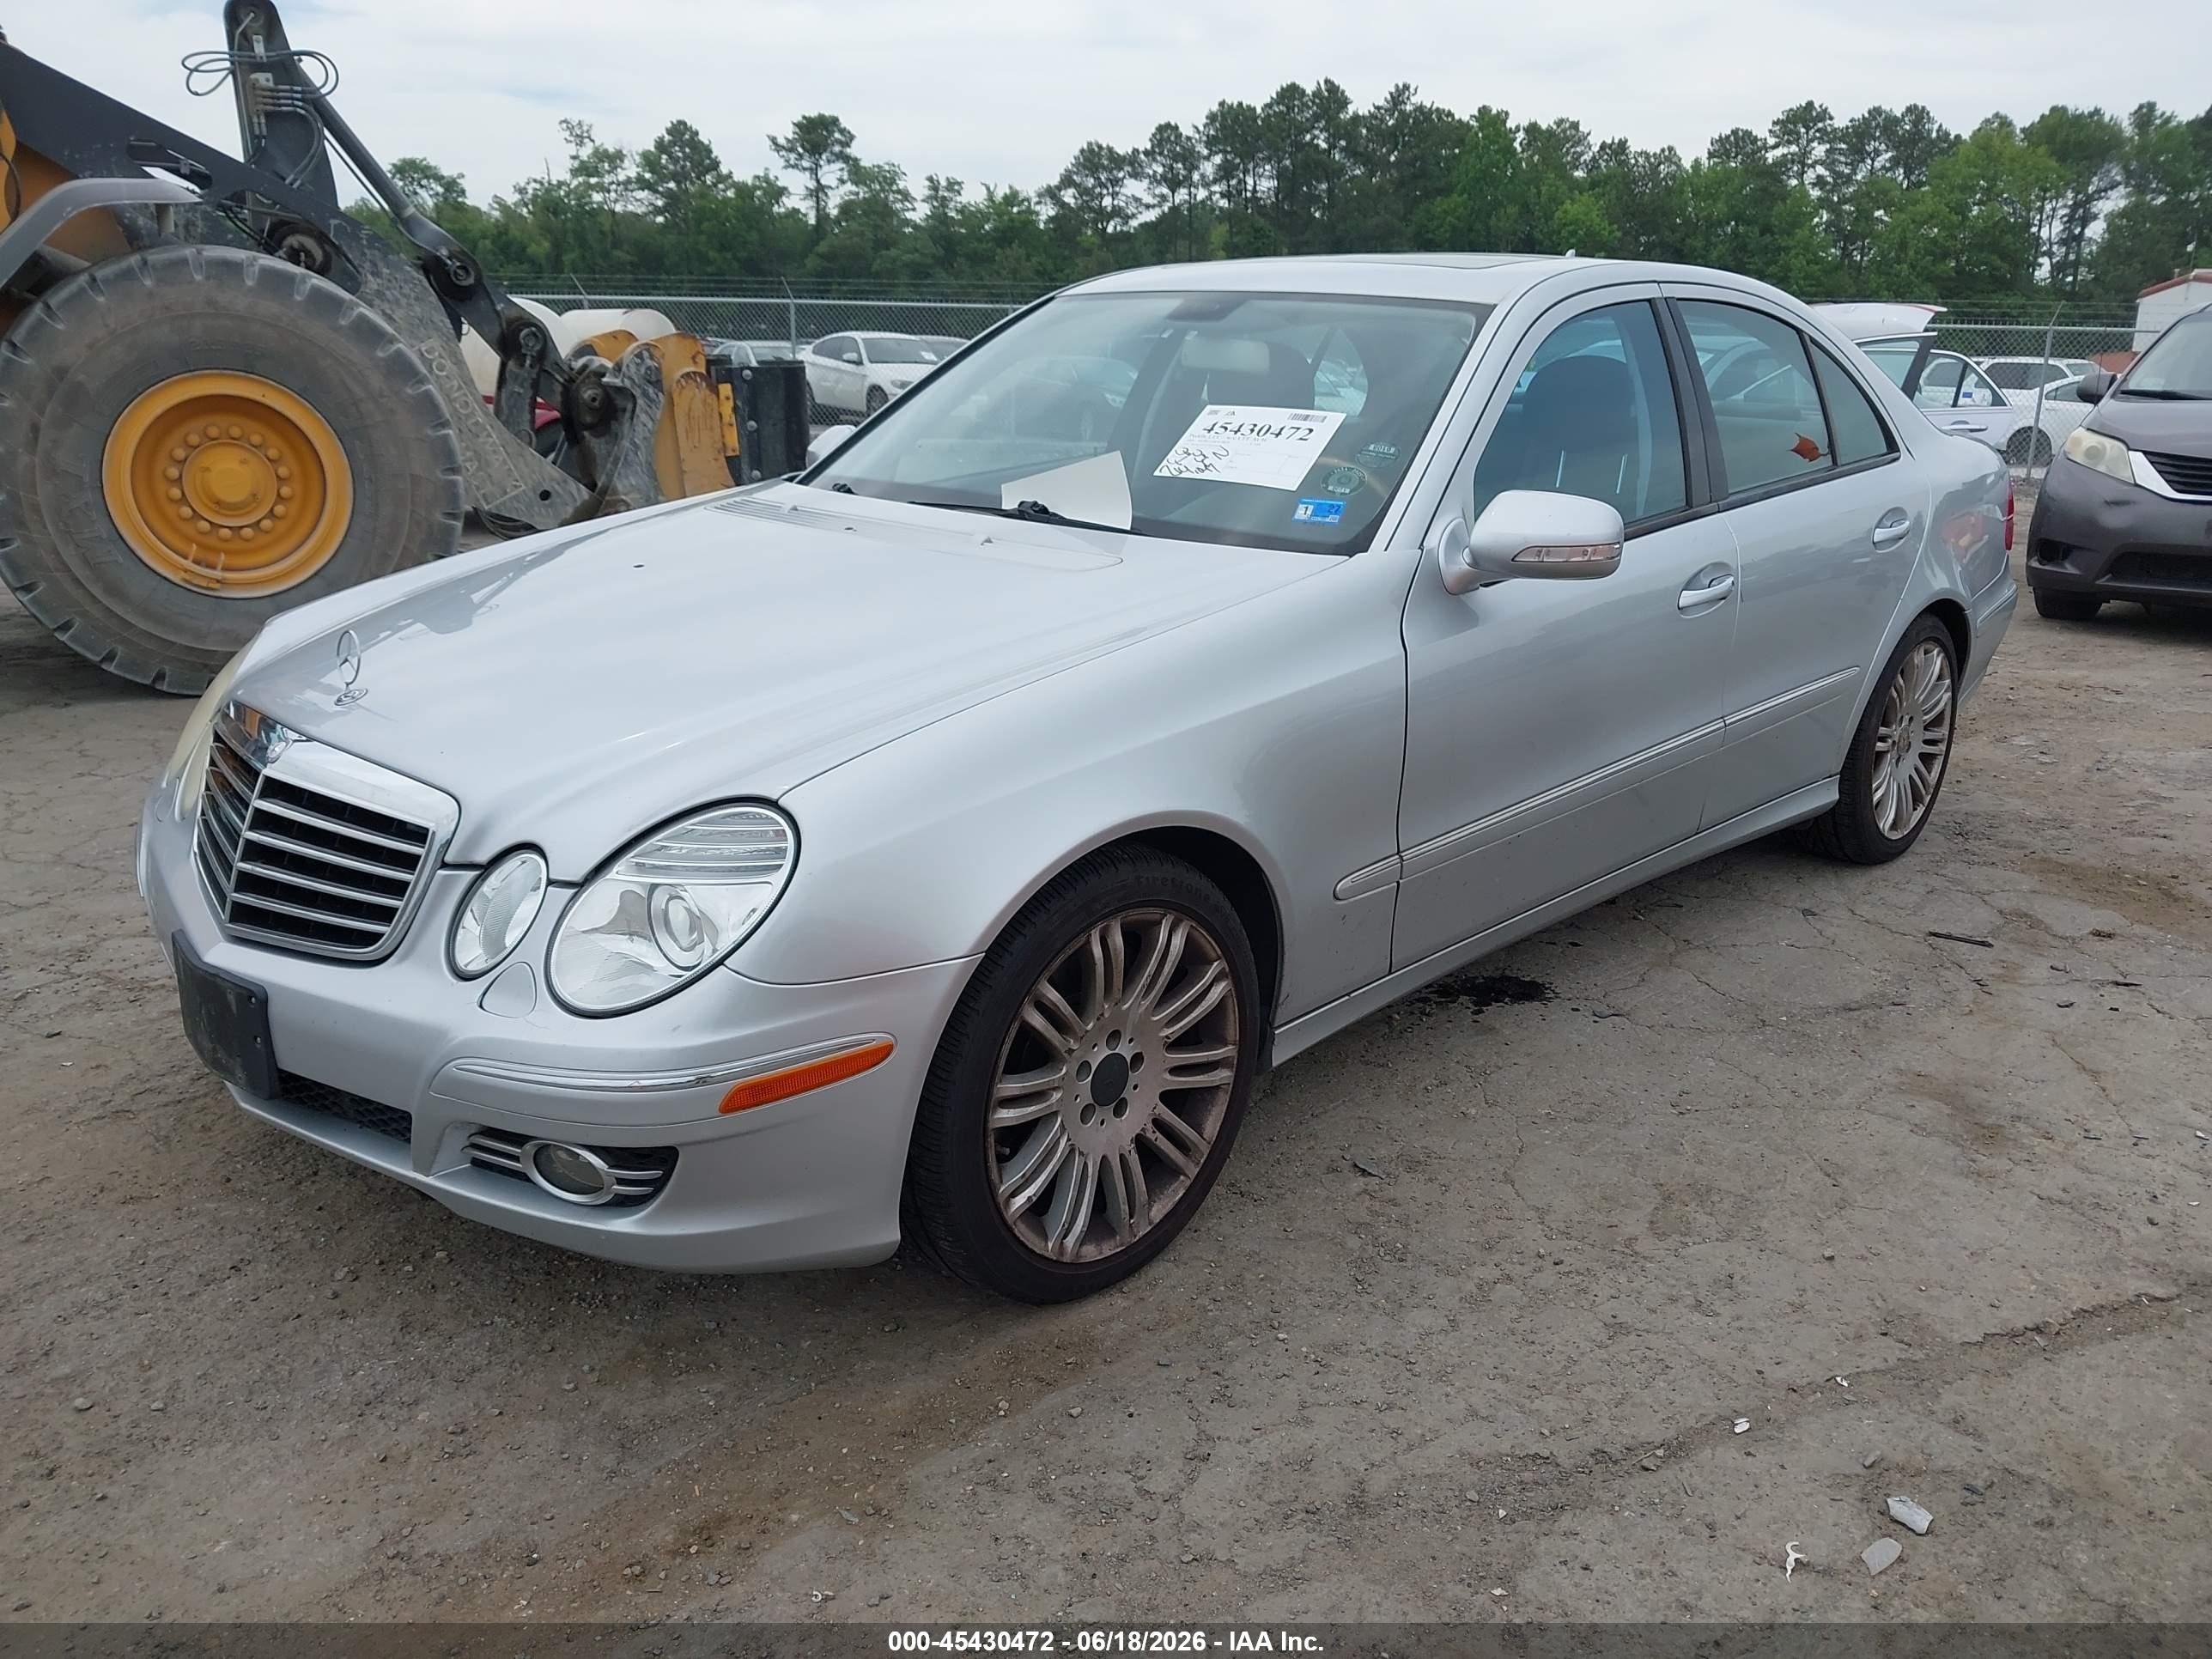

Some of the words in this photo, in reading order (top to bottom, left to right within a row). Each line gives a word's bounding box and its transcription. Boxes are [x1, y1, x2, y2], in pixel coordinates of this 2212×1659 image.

[420, 344, 448, 376] DO
[445, 380, 483, 429] NOT
[1203, 421, 1314, 441] 45430472
